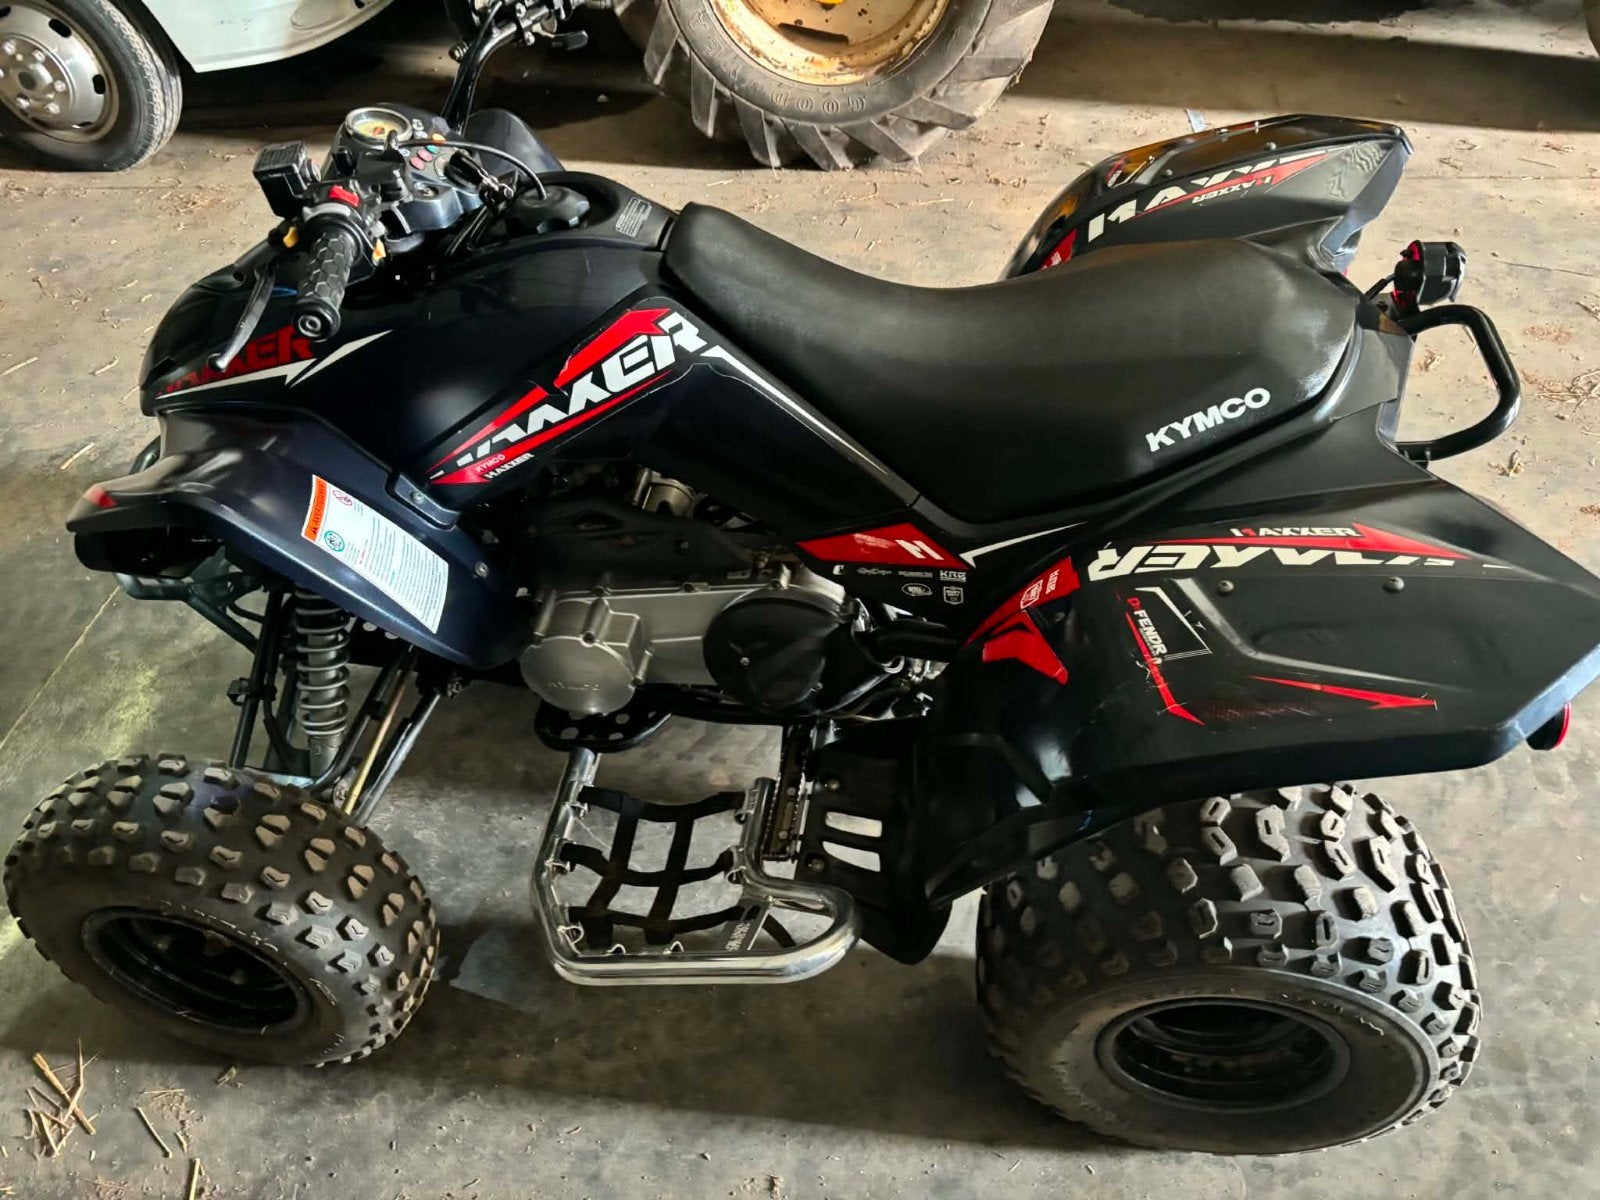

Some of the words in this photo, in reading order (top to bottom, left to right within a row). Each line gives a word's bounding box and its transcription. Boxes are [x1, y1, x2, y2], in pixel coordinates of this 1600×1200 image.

[1145, 387, 1271, 453] KYMCO
[474, 453, 506, 474] KYMCO
[1231, 527, 1362, 537] MAXXER
